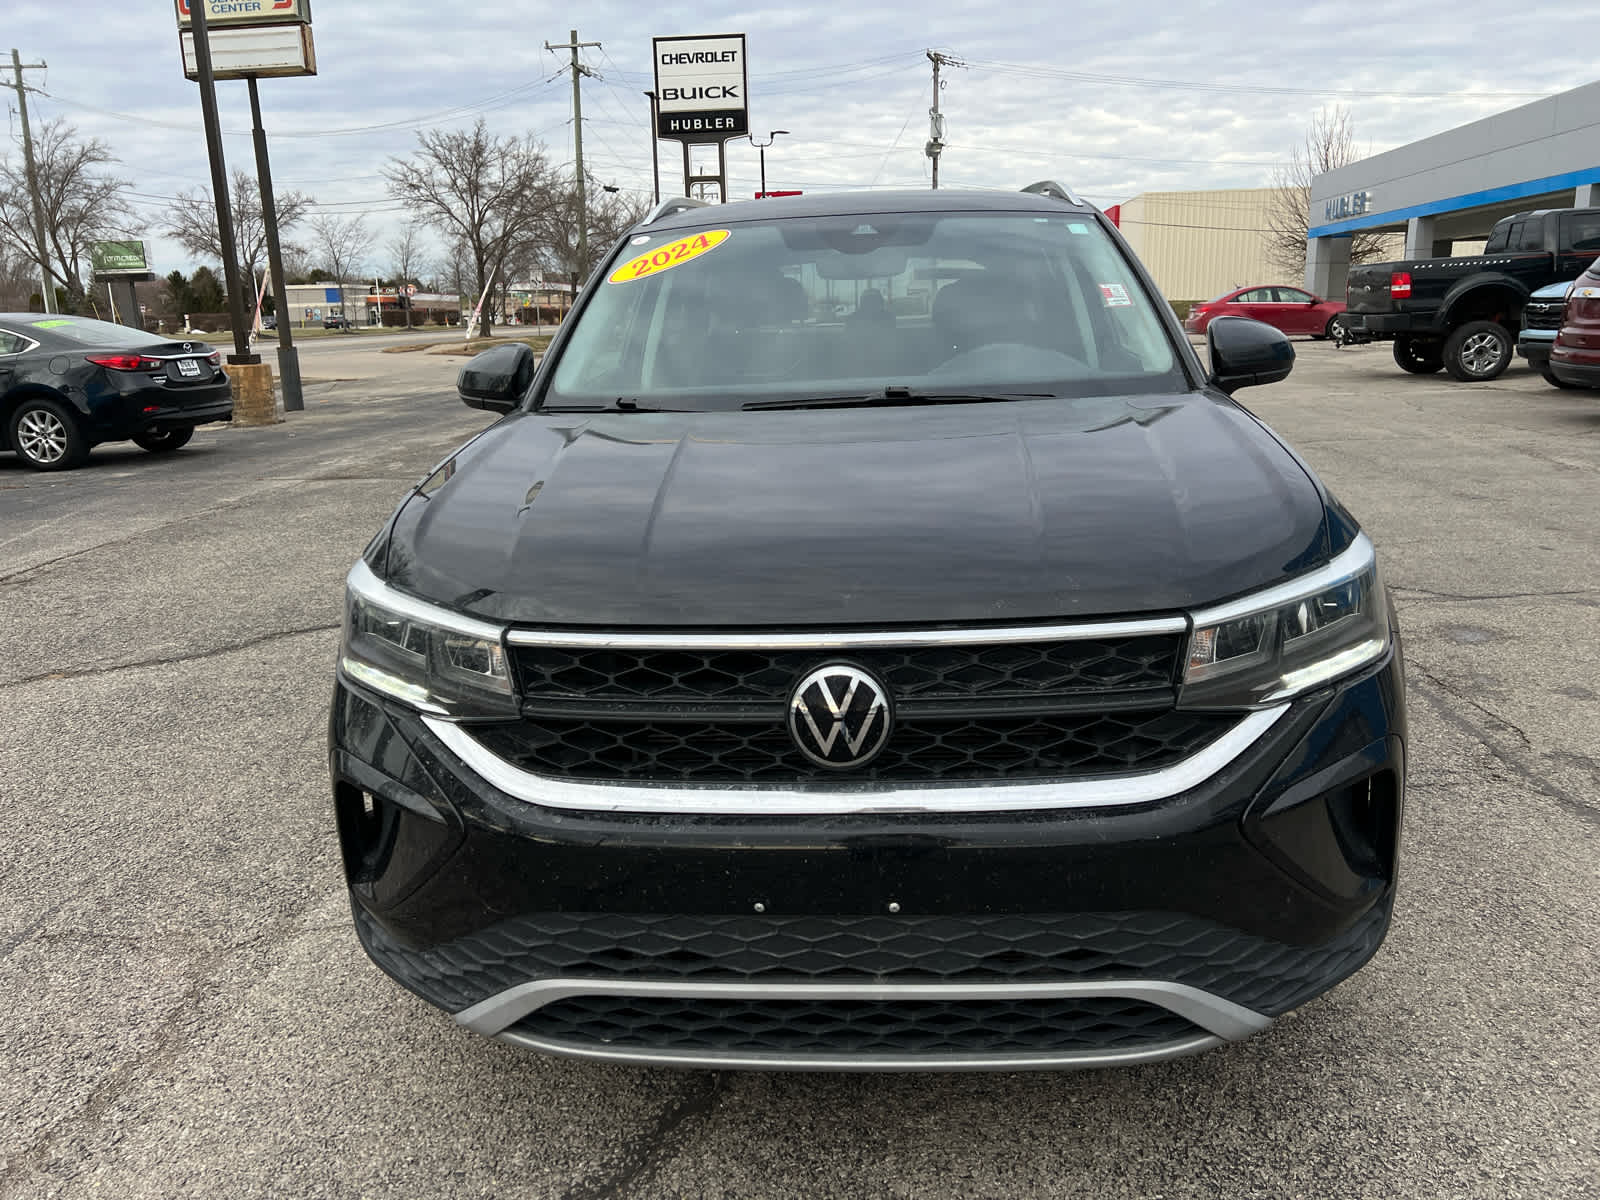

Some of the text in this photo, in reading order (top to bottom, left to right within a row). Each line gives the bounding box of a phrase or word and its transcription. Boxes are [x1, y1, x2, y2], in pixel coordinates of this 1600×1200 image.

[211, 2, 261, 14] CENTER
[661, 50, 737, 65] CHEVROLET
[662, 85, 740, 100] BUICK
[670, 117, 735, 130] HUBLER
[632, 234, 712, 277] 2024
